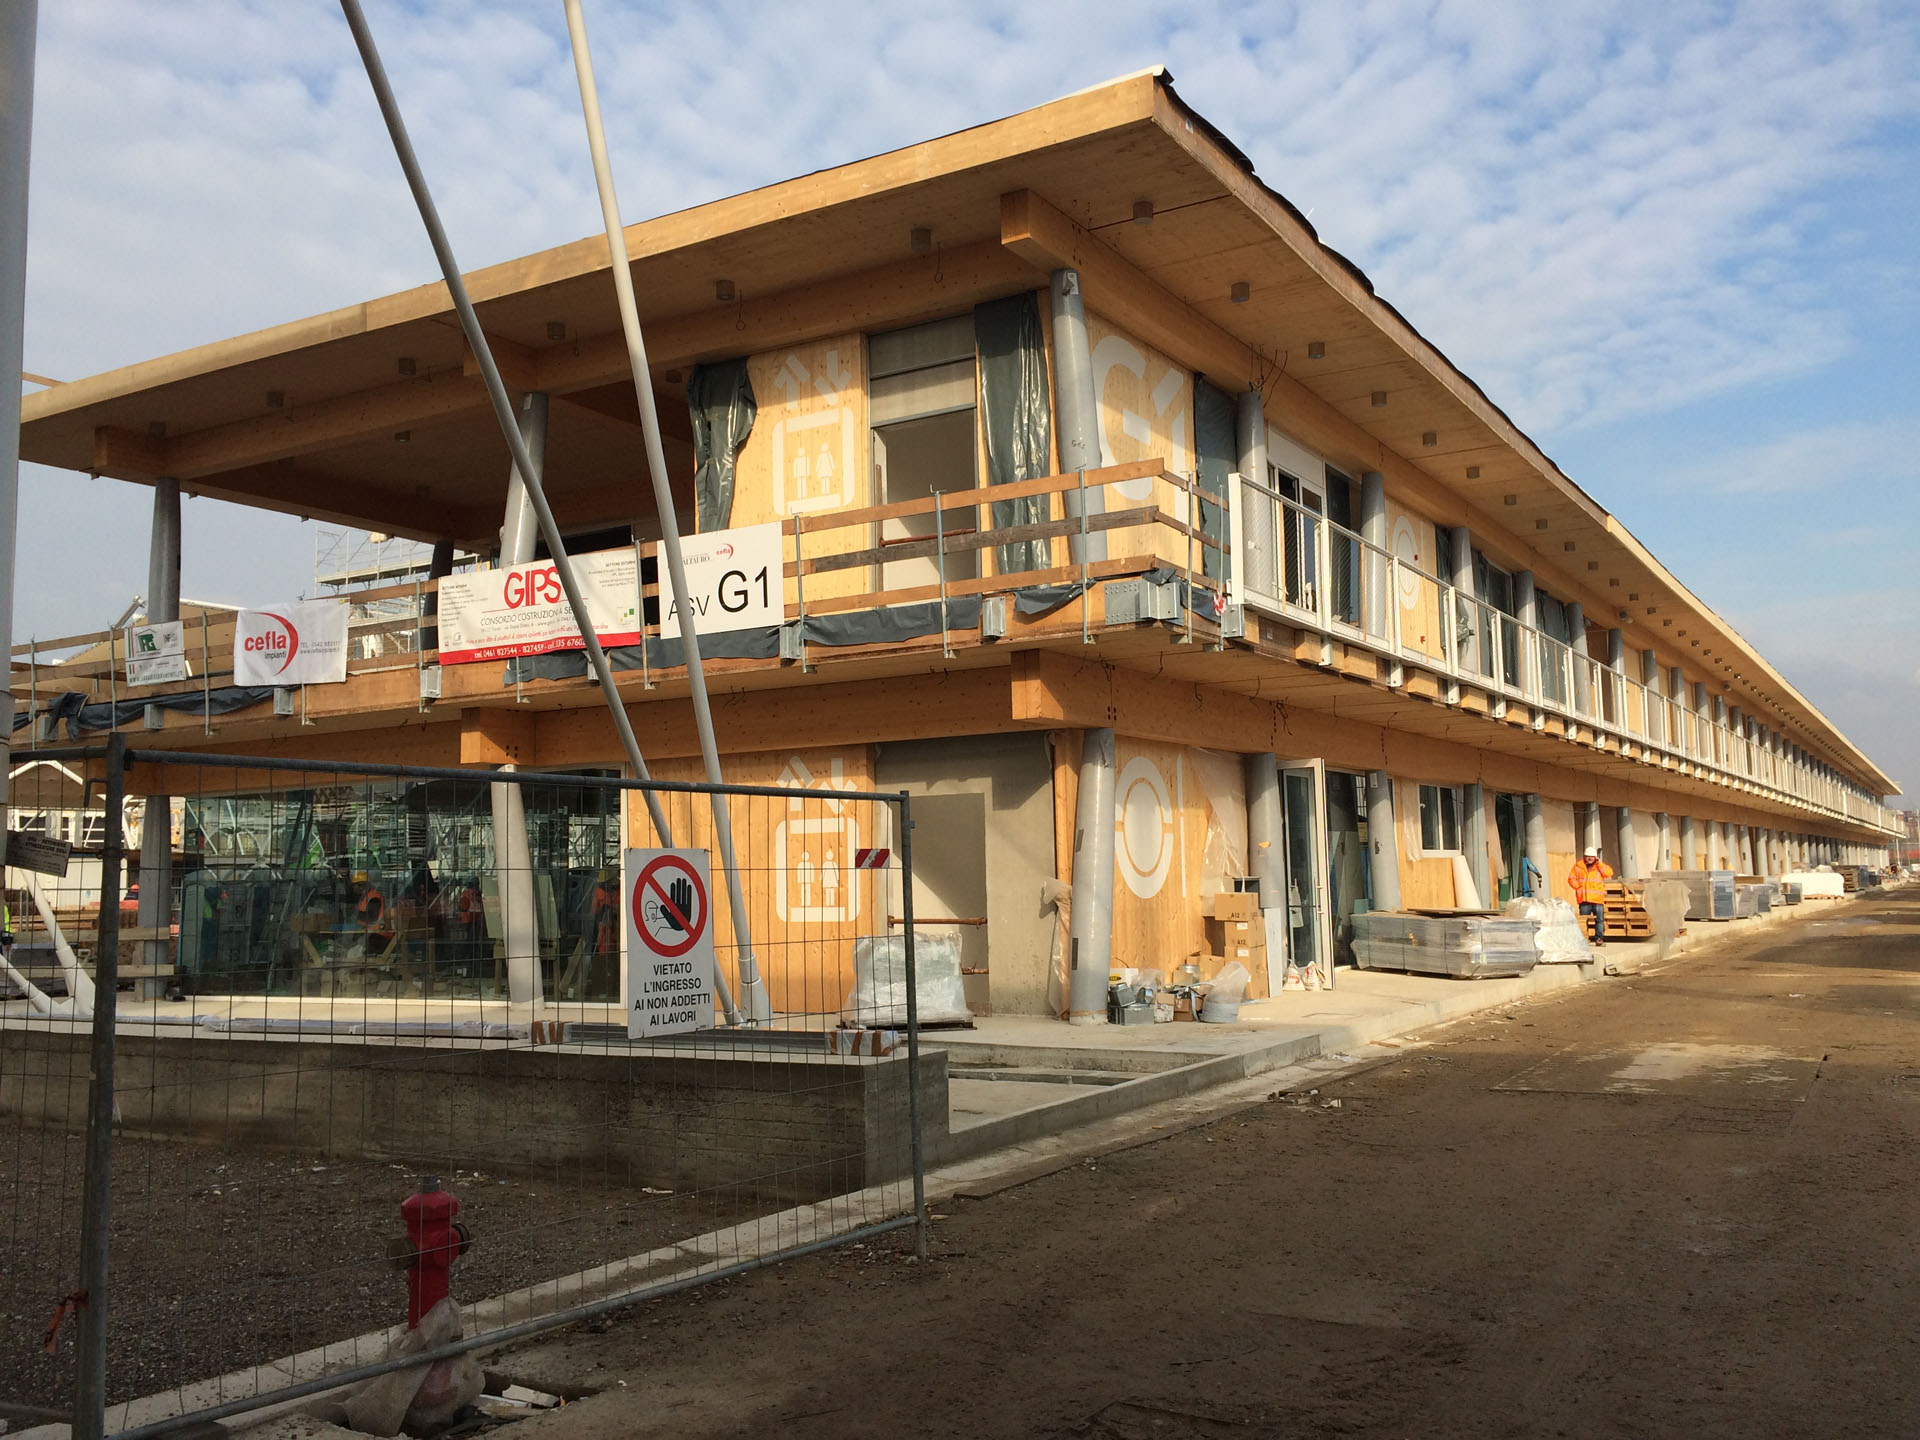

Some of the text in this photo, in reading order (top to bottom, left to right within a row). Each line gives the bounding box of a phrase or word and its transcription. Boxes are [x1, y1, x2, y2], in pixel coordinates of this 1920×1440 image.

[503, 567, 562, 609] GIPS
[718, 566, 769, 613] G1
[480, 614, 517, 626] CONSORZIO
[244, 631, 287, 652] cefla
[264, 651, 287, 660] impianti
[653, 962, 692, 976] VIETATO
[644, 978, 701, 993] L'INGRESSO
[634, 993, 711, 1011] AI NON ADDETTI
[649, 1010, 696, 1026] AI LAVORI
